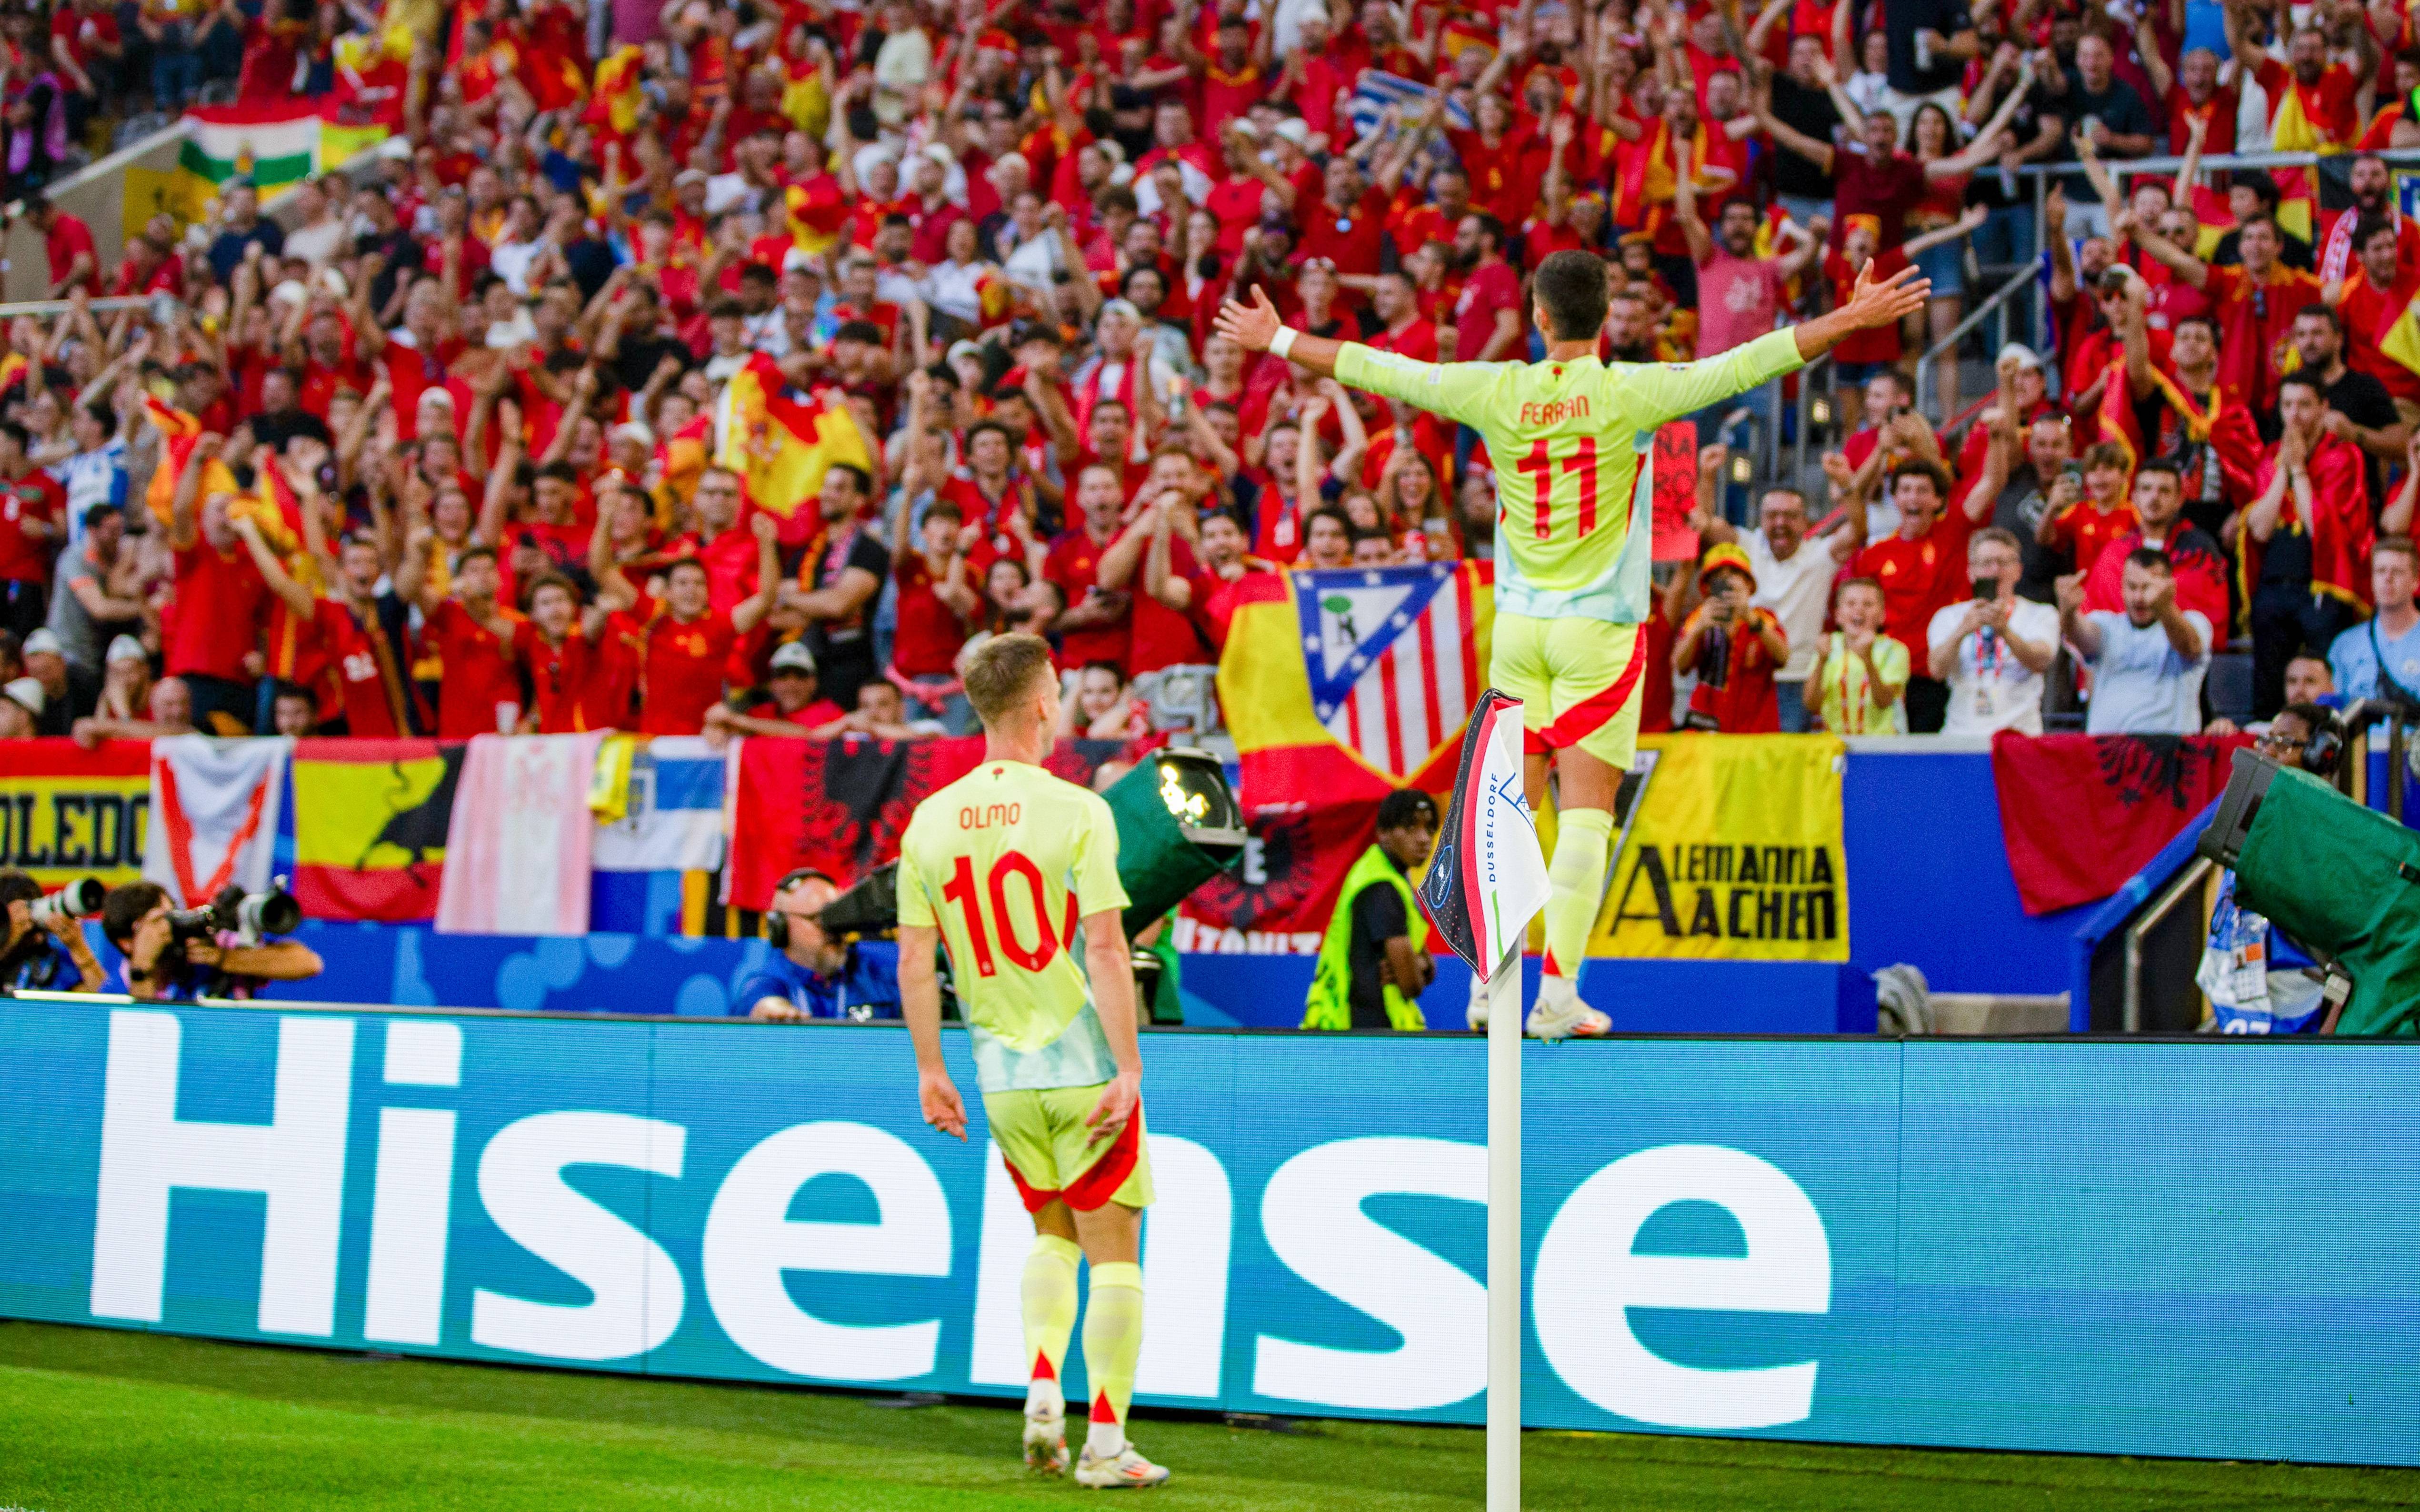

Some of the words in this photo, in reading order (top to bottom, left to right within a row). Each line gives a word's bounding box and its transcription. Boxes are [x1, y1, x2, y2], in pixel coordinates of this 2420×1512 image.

[1520, 395, 1590, 425] FERRAN
[1516, 437, 1597, 539] 11
[960, 802, 1021, 830] OLMO
[1487, 773, 1499, 883] DUSSELDORF
[942, 849, 1059, 977] 10
[90, 1011, 1833, 1429] Hisense
